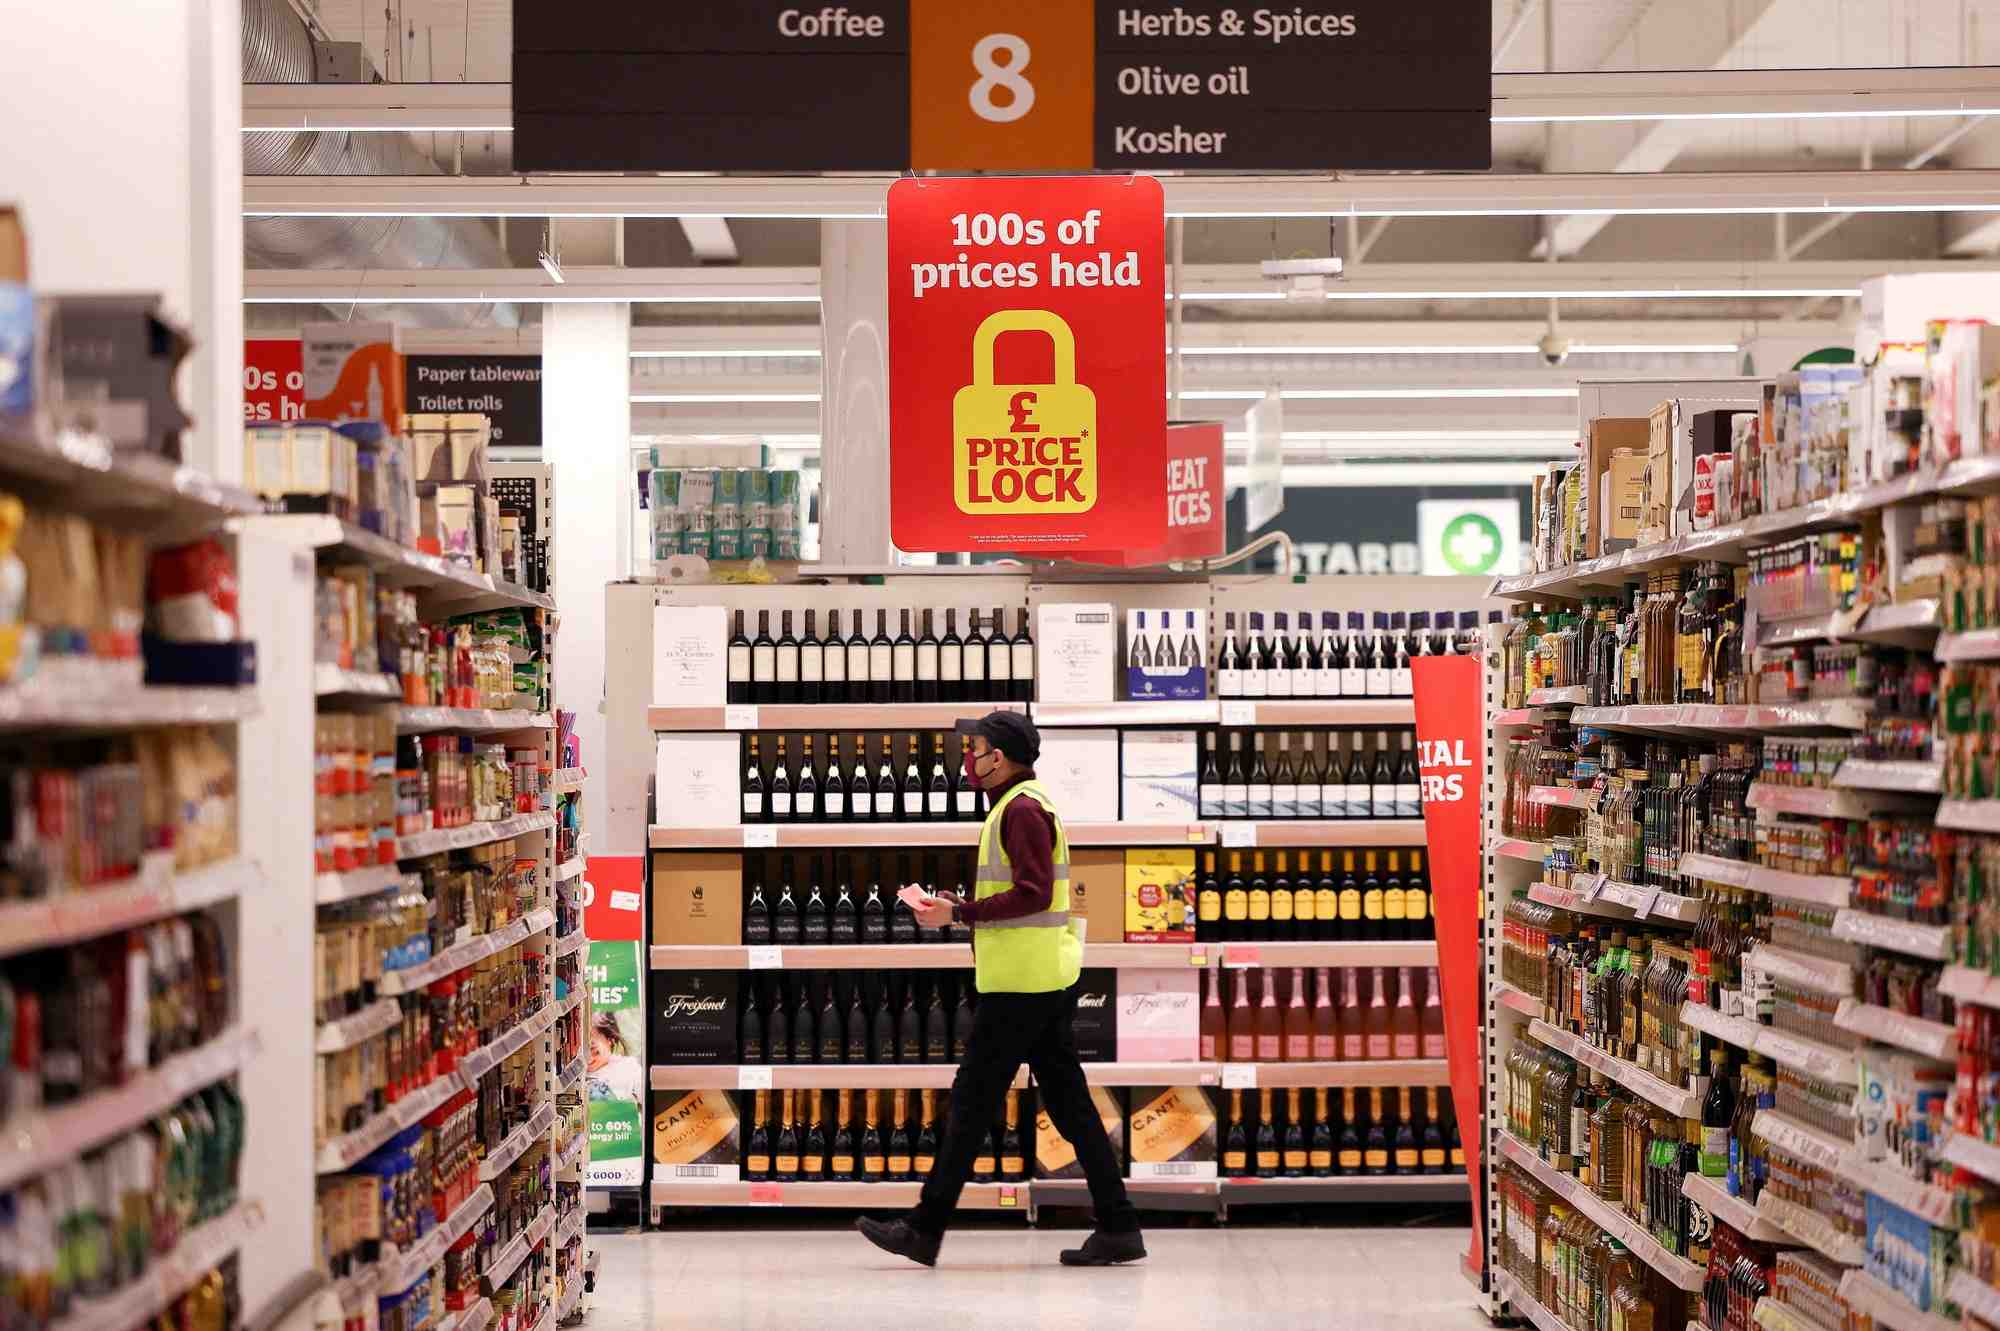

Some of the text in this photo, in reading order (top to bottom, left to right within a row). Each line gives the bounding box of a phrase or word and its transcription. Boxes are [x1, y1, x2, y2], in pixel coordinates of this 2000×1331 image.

[778, 8, 884, 37] Coffee
[1118, 8, 1357, 43] Herbs & Spices
[968, 33, 1036, 123] 8
[1117, 66, 1250, 95] Olive oil
[1115, 125, 1227, 154] Kosher
[951, 210, 1102, 247] 100s of
[911, 252, 1141, 298] prices held
[418, 366, 466, 385] Paper
[417, 395, 504, 411] Toilet rolls
[1007, 391, 1041, 433] £
[967, 467, 1086, 504] LOCK
[1167, 457, 1208, 492] EAT
[605, 1121, 633, 1133] 60%
[655, 1095, 705, 1132] CANTI
[1131, 1093, 1182, 1132] CANTI
[593, 1170, 622, 1180] GOOD
